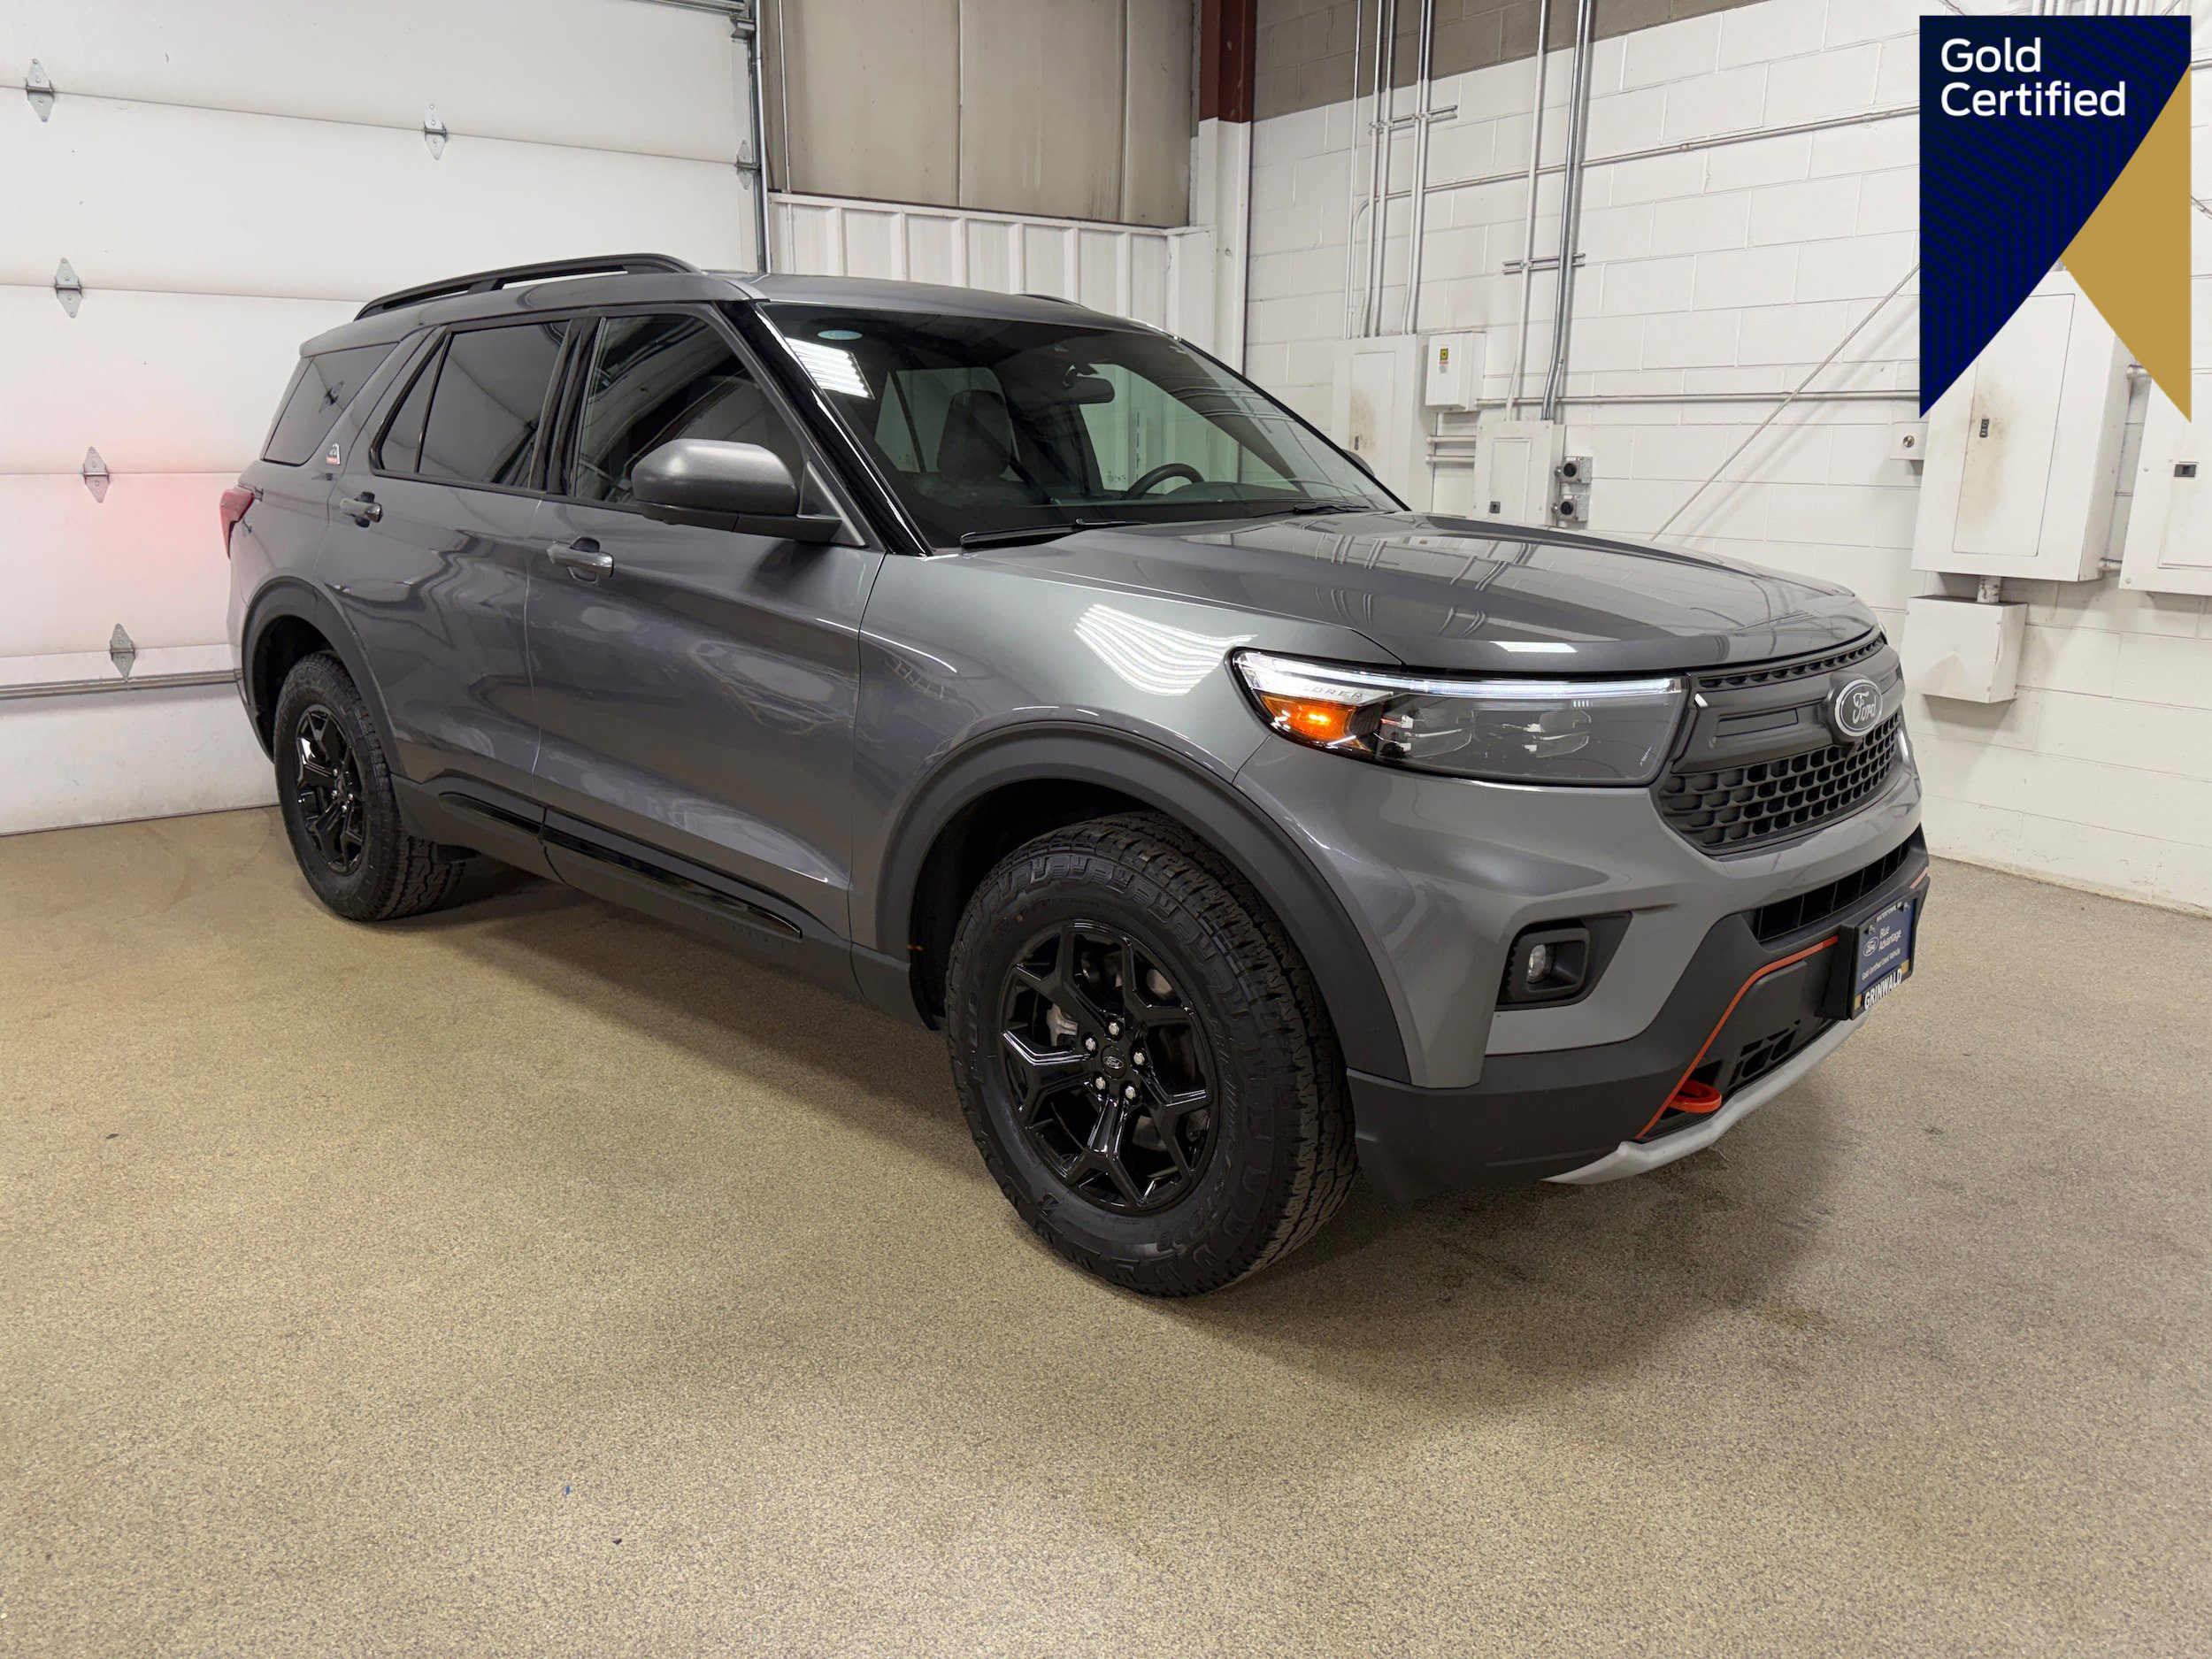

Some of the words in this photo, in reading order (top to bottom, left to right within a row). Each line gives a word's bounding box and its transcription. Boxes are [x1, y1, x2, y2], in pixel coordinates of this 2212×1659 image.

[1852, 691, 1877, 725] Ford
[1878, 929, 1901, 951] Advantage
[1864, 967, 1902, 1010] GRINWALD
